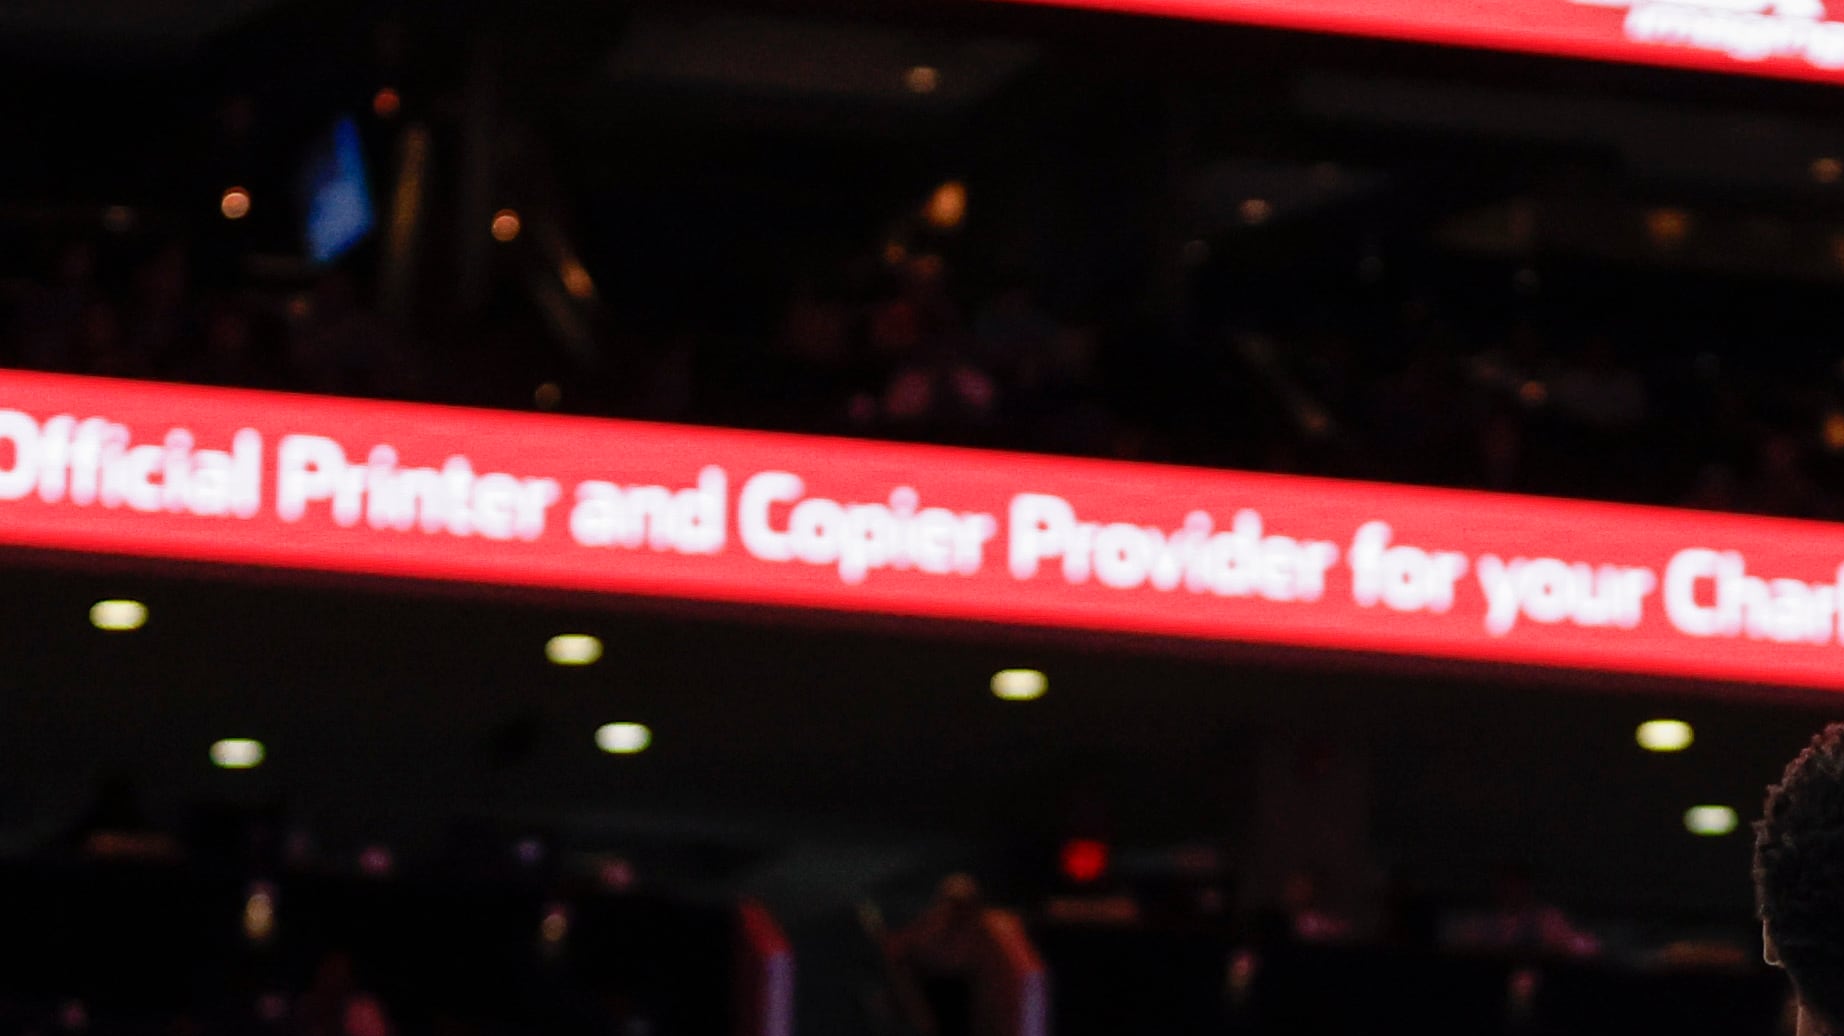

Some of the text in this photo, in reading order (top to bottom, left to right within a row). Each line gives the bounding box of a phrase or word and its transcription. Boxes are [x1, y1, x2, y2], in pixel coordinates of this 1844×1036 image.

[276, 434, 561, 540] Printer
[570, 466, 728, 554] and
[738, 472, 997, 583] Copier
[1008, 494, 1339, 601] Provider
[1348, 521, 1468, 612] for
[1477, 555, 1656, 635] your
